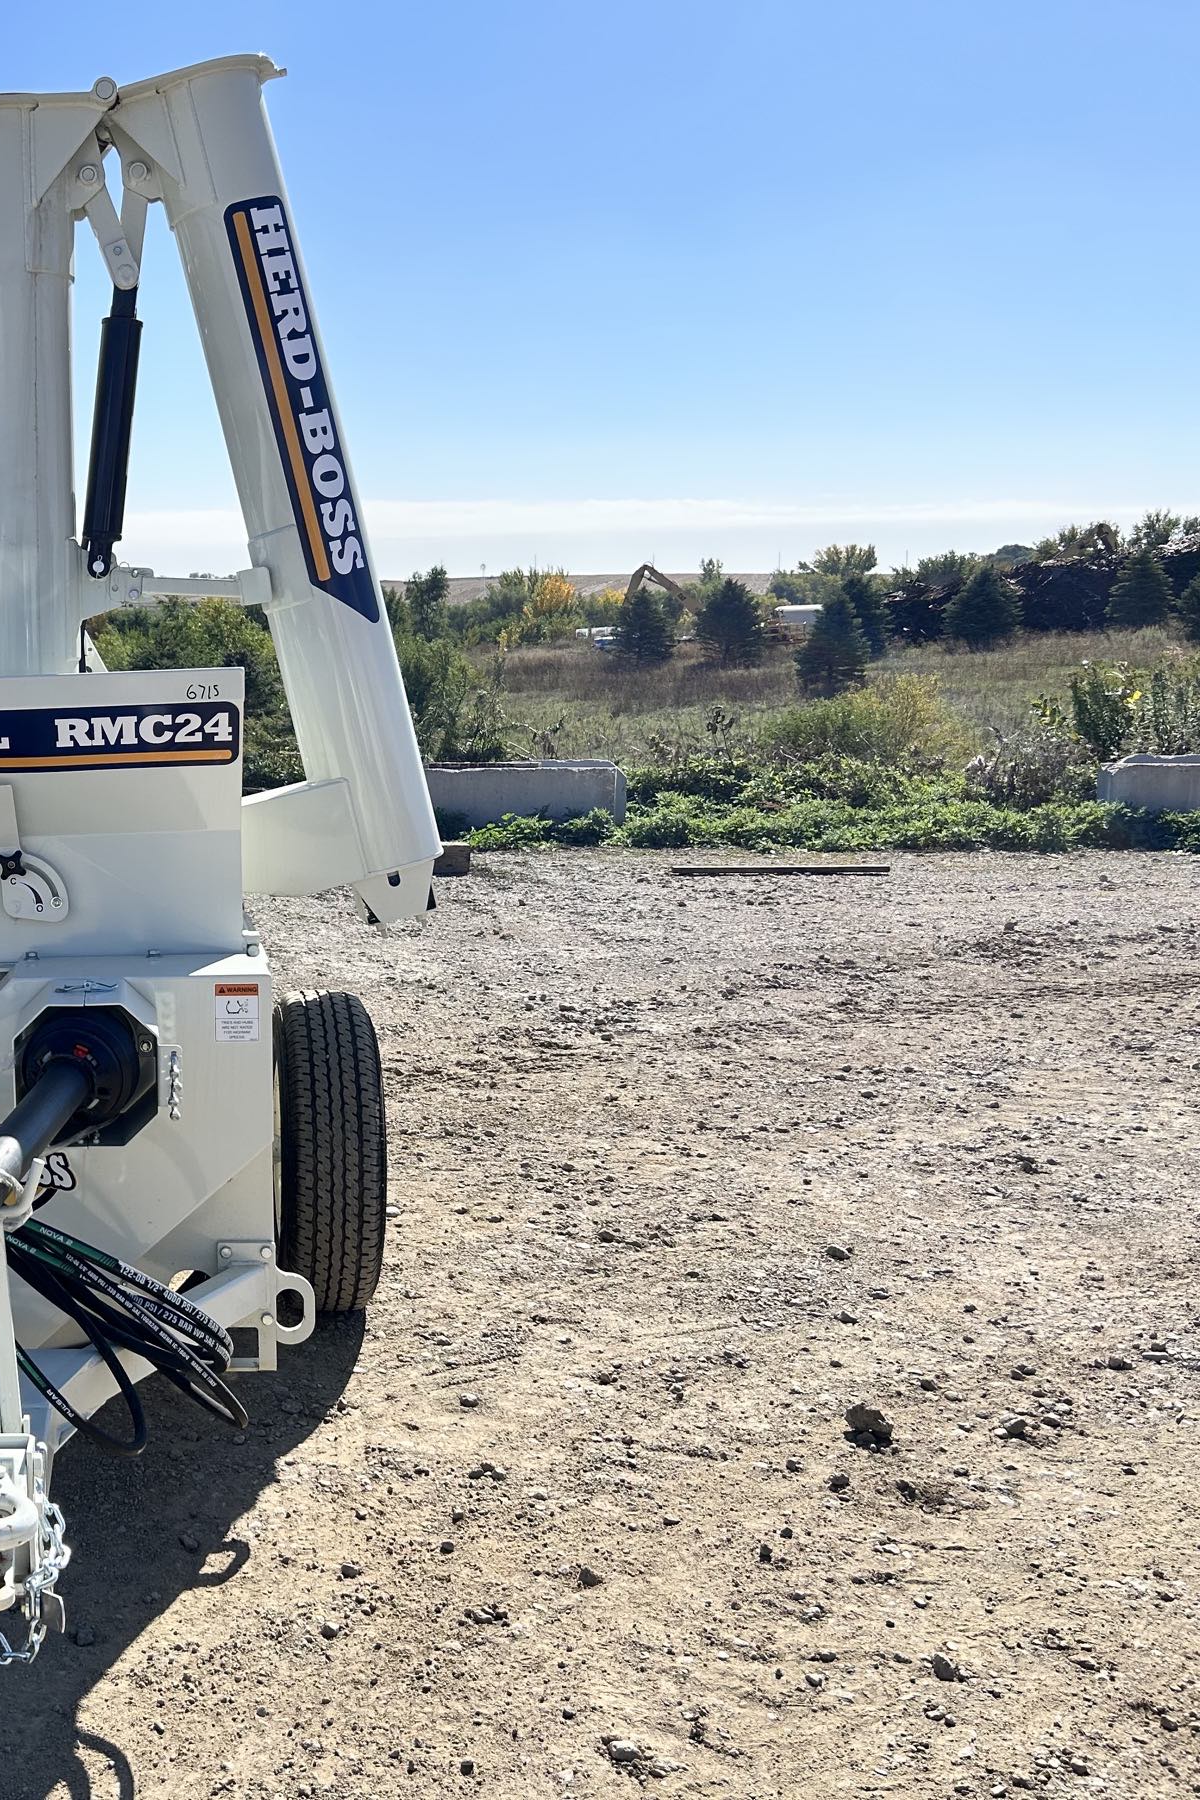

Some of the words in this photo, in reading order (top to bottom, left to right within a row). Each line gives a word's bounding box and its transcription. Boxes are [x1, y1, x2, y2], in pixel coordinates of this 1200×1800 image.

[250, 204, 365, 576] HERD-BOSS
[55, 711, 233, 748] RMC24
[10, 877, 17, 885] C
[6, 1234, 29, 1251] NOVA
[29, 1247, 37, 1255] 2
[39, 1226, 64, 1243] NOVA
[119, 1264, 146, 1285] 122-08
[162, 1289, 182, 1306] 4000
[180, 1301, 193, 1314] PSI
[196, 1311, 209, 1325] 275
[131, 1305, 142, 1316] SAE
[144, 1299, 158, 1313] PSI
[162, 1310, 178, 1325] 275
[178, 1319, 193, 1334] BAR
[192, 1327, 205, 1339] WP
[203, 1334, 216, 1348] SAE
[46, 1388, 75, 1418] PULSAR
